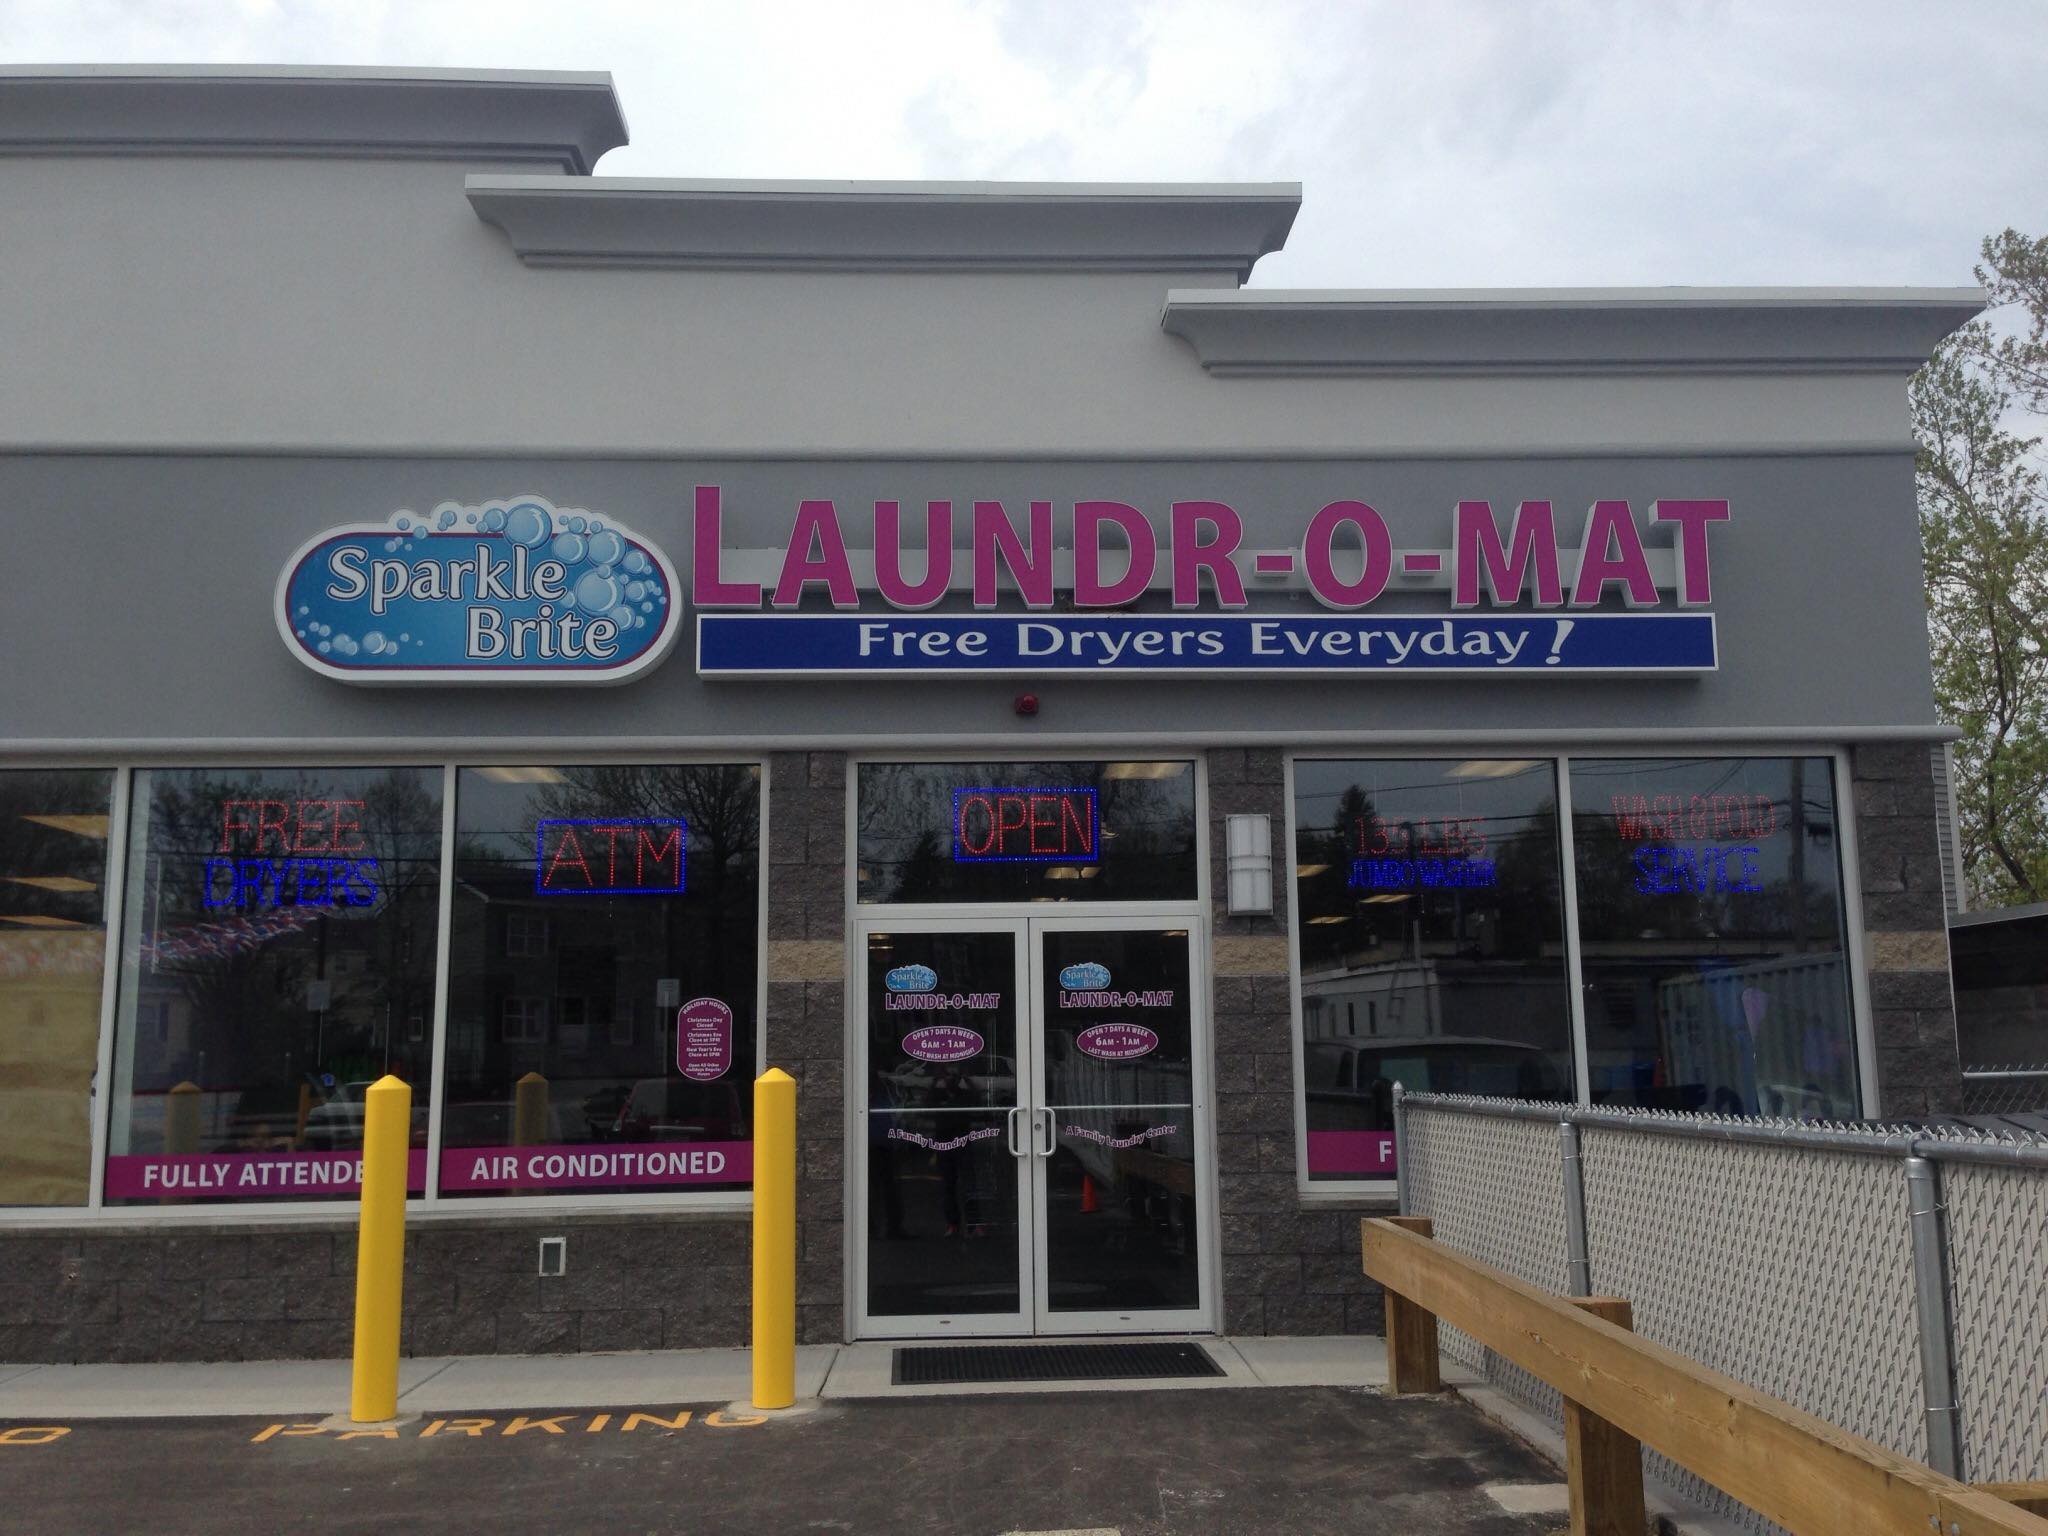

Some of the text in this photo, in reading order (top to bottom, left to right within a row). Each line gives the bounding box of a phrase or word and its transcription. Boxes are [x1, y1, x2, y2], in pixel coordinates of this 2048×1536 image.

[693, 485, 1731, 608] LAUNDR-O-MAT
[327, 544, 567, 615] Sparkle
[465, 604, 618, 660] Brite
[859, 622, 988, 657] Free
[1017, 622, 1225, 665] Dryers
[219, 799, 367, 852] FREE
[959, 795, 1092, 854] OPEN
[1612, 794, 1686, 840] WASH
[1711, 794, 1777, 839] FOLD
[543, 826, 681, 887] ATM
[203, 857, 378, 907] DRYERS
[1634, 847, 1763, 895] SERVICE
[891, 971, 922, 982] Sparkle
[909, 980, 930, 990] Brite
[1066, 970, 1096, 980] Sparkle
[682, 1000, 729, 1015] HOLIDAY HOURS
[885, 992, 1001, 1010] LAUNDR-O-MAT
[1059, 990, 1174, 1008] LAUNDR-O-MAT
[912, 1030, 929, 1040] OPEN
[957, 1030, 975, 1041] WEEK
[1086, 1027, 1103, 1038] OPEN
[1109, 1025, 1125, 1033] DAYS
[1131, 1027, 1149, 1038] WEEK
[1095, 1037, 1114, 1046] 6AM
[1122, 1036, 1140, 1046] 1AM
[912, 1048, 926, 1058] LAST
[926, 1052, 941, 1060] WASH
[949, 1047, 976, 1059] MIDNIGHT
[921, 1040, 940, 1049] 6AM
[948, 1039, 966, 1048] 1AM
[1087, 1046, 1101, 1056] LAST
[1101, 1049, 1117, 1057] WASH
[1124, 1044, 1150, 1056] MIDNIGHT
[887, 1128, 1000, 1151] A Family Laundry Center
[1065, 1125, 1177, 1148] A Family Laundry Center
[143, 1160, 364, 1188] FULLY ATTENDE
[471, 1151, 726, 1180] AIR CONDITIONED
[250, 1411, 770, 1442] PARKING
